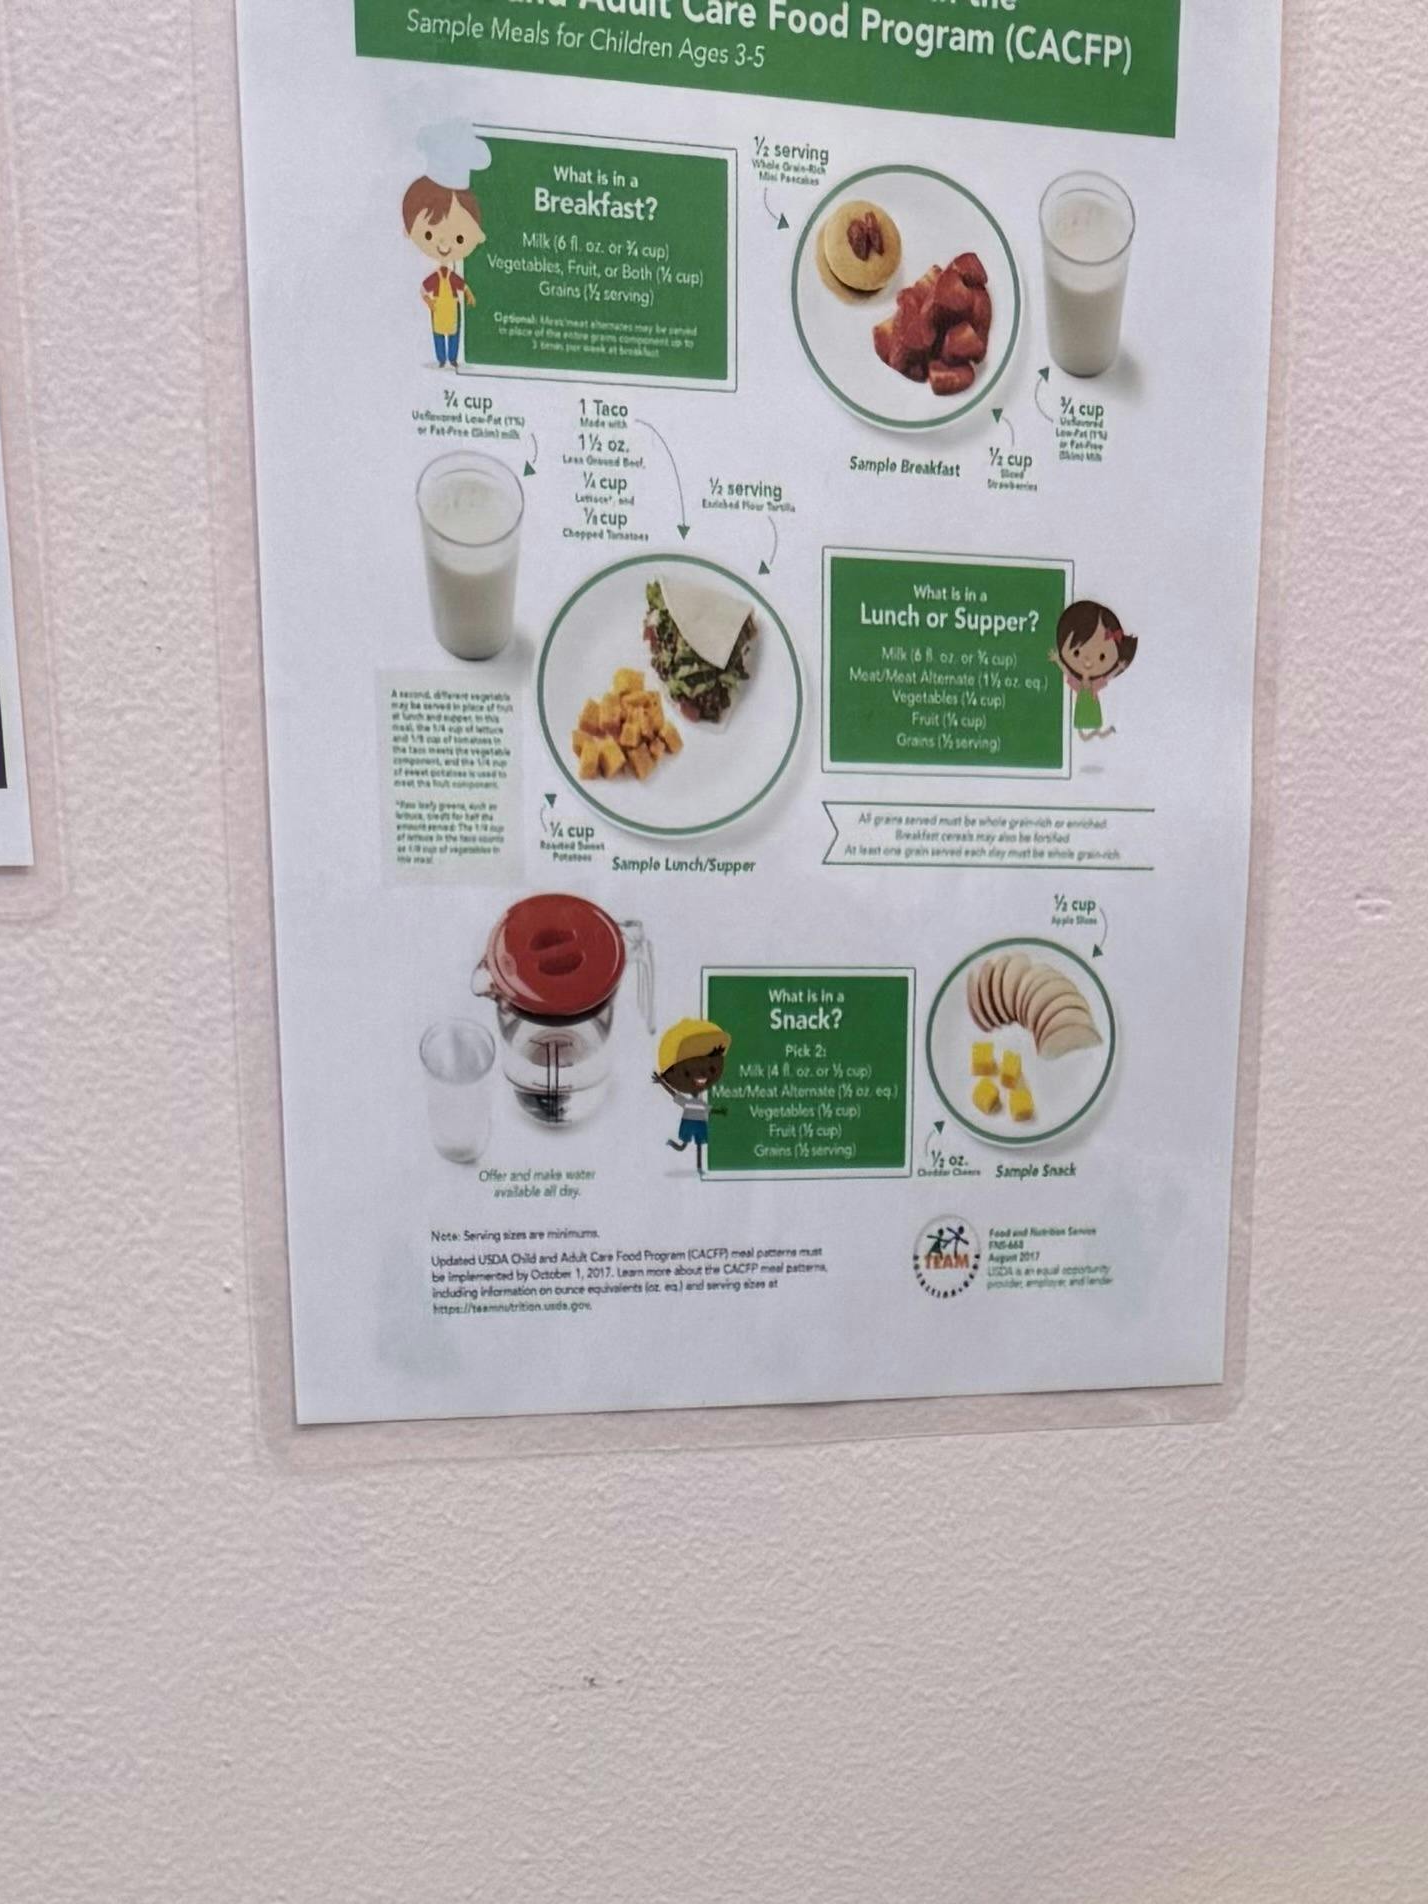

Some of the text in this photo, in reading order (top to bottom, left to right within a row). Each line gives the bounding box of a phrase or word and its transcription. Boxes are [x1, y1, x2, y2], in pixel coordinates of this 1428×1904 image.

[405, 11, 765, 68] Sample Meals for Children Ages 3-5
[770, 4, 849, 37] Food
[861, 11, 994, 56] Program
[1005, 28, 1134, 74] (CACFP)
[534, 187, 658, 222] Breakfast?
[848, 457, 961, 476] Sample Breakfast
[859, 603, 1039, 636] Lunch or Supper?
[612, 855, 756, 877] Sample Lunch/Supper
[769, 1006, 842, 1034] Snack?
[995, 1163, 1077, 1180] Sample Snack
[924, 1253, 968, 1271] TEAM
